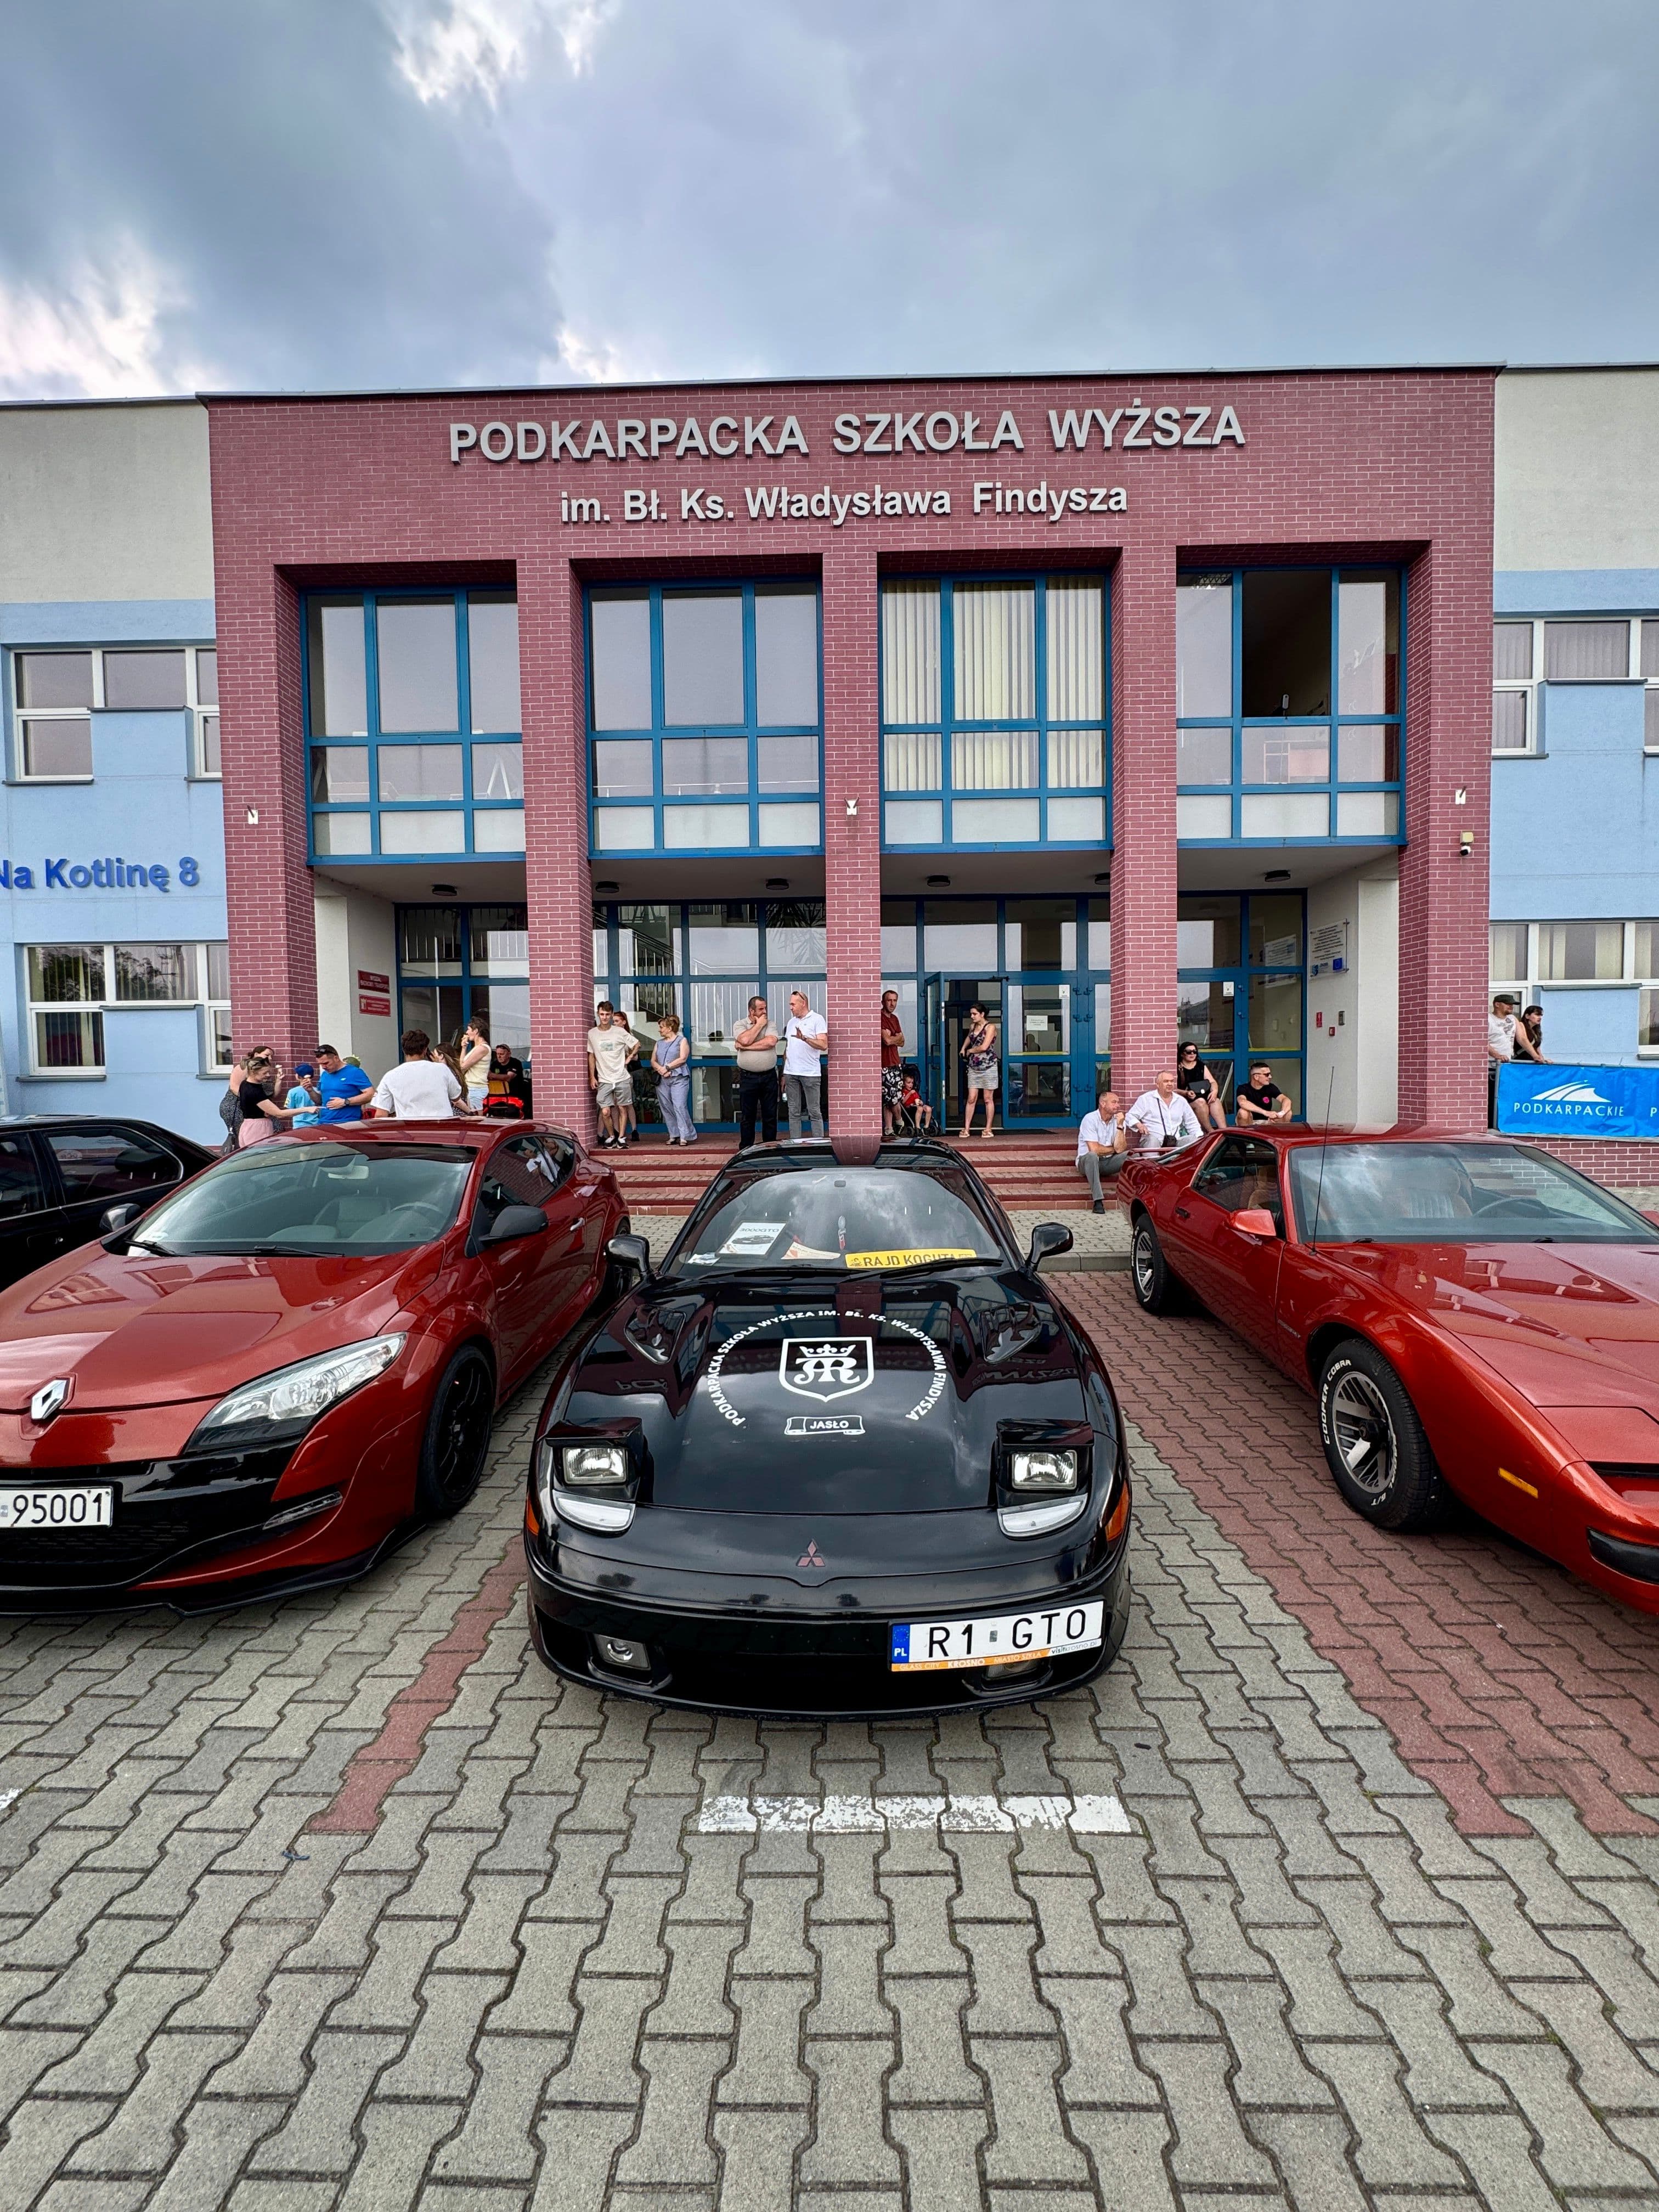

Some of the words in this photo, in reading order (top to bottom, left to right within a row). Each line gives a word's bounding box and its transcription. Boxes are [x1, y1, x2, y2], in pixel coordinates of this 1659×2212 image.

[449, 415, 809, 464] PODKARPACKA
[832, 410, 1024, 454] SZKOŁA
[1048, 398, 1245, 450] WYŻSZA
[561, 492, 610, 523] im.
[624, 489, 667, 522] Bł.
[681, 488, 734, 520] Ks.
[744, 485, 951, 527] Władysława
[973, 481, 1128, 522] Findysza
[45, 857, 170, 893] Kotlinę
[179, 856, 200, 887] 8
[1514, 1102, 1624, 1117] PODKARPACKIE
[757, 1311, 815, 1327] WYŻSZA
[868, 1313, 887, 1323] KS.
[718, 1325, 759, 1354] SZKOŁA
[890, 1319, 947, 1371] WŁADYSŁAWA
[707, 1354, 746, 1426] PODKARPACKA
[905, 1372, 947, 1421] FINDYSZA
[1321, 1383, 1330, 1444] COOPER
[1327, 1359, 1352, 1381] COBRA
[810, 1420, 849, 1429] JASŁO
[12, 1492, 103, 1526] 95001
[928, 1623, 973, 1658] R1
[1012, 1609, 1086, 1649] GTO
[894, 1647, 907, 1657] PL
[947, 1658, 985, 1668] KROSNO
[994, 1655, 1020, 1663] MIASTO
[1022, 1652, 1043, 1661] SZKŁA
